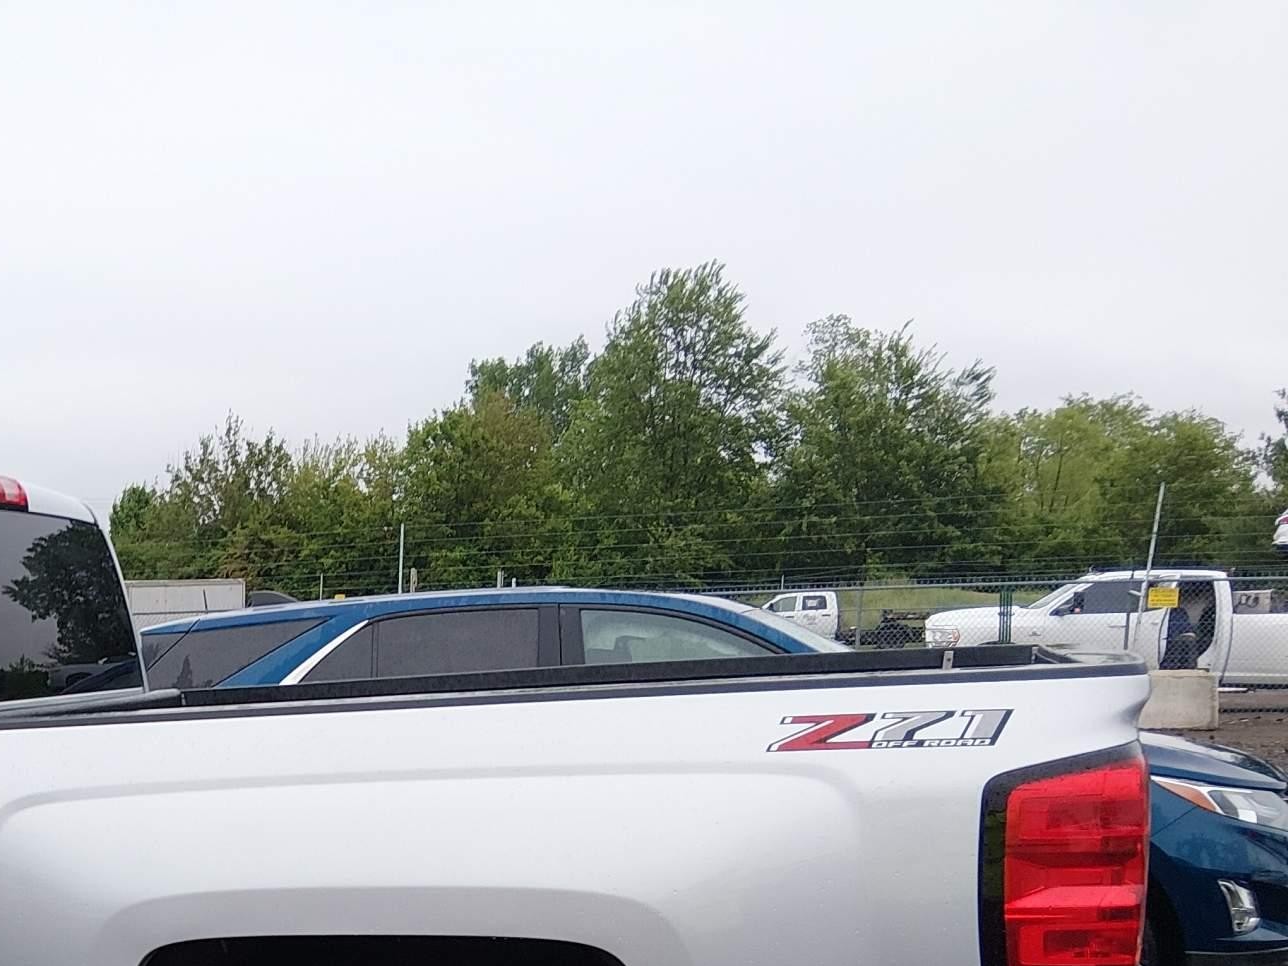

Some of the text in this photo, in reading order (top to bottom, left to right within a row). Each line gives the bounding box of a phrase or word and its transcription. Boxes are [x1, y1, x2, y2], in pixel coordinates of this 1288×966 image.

[766, 709, 1014, 752] Z71
[871, 738, 992, 749] OFF ROAD
